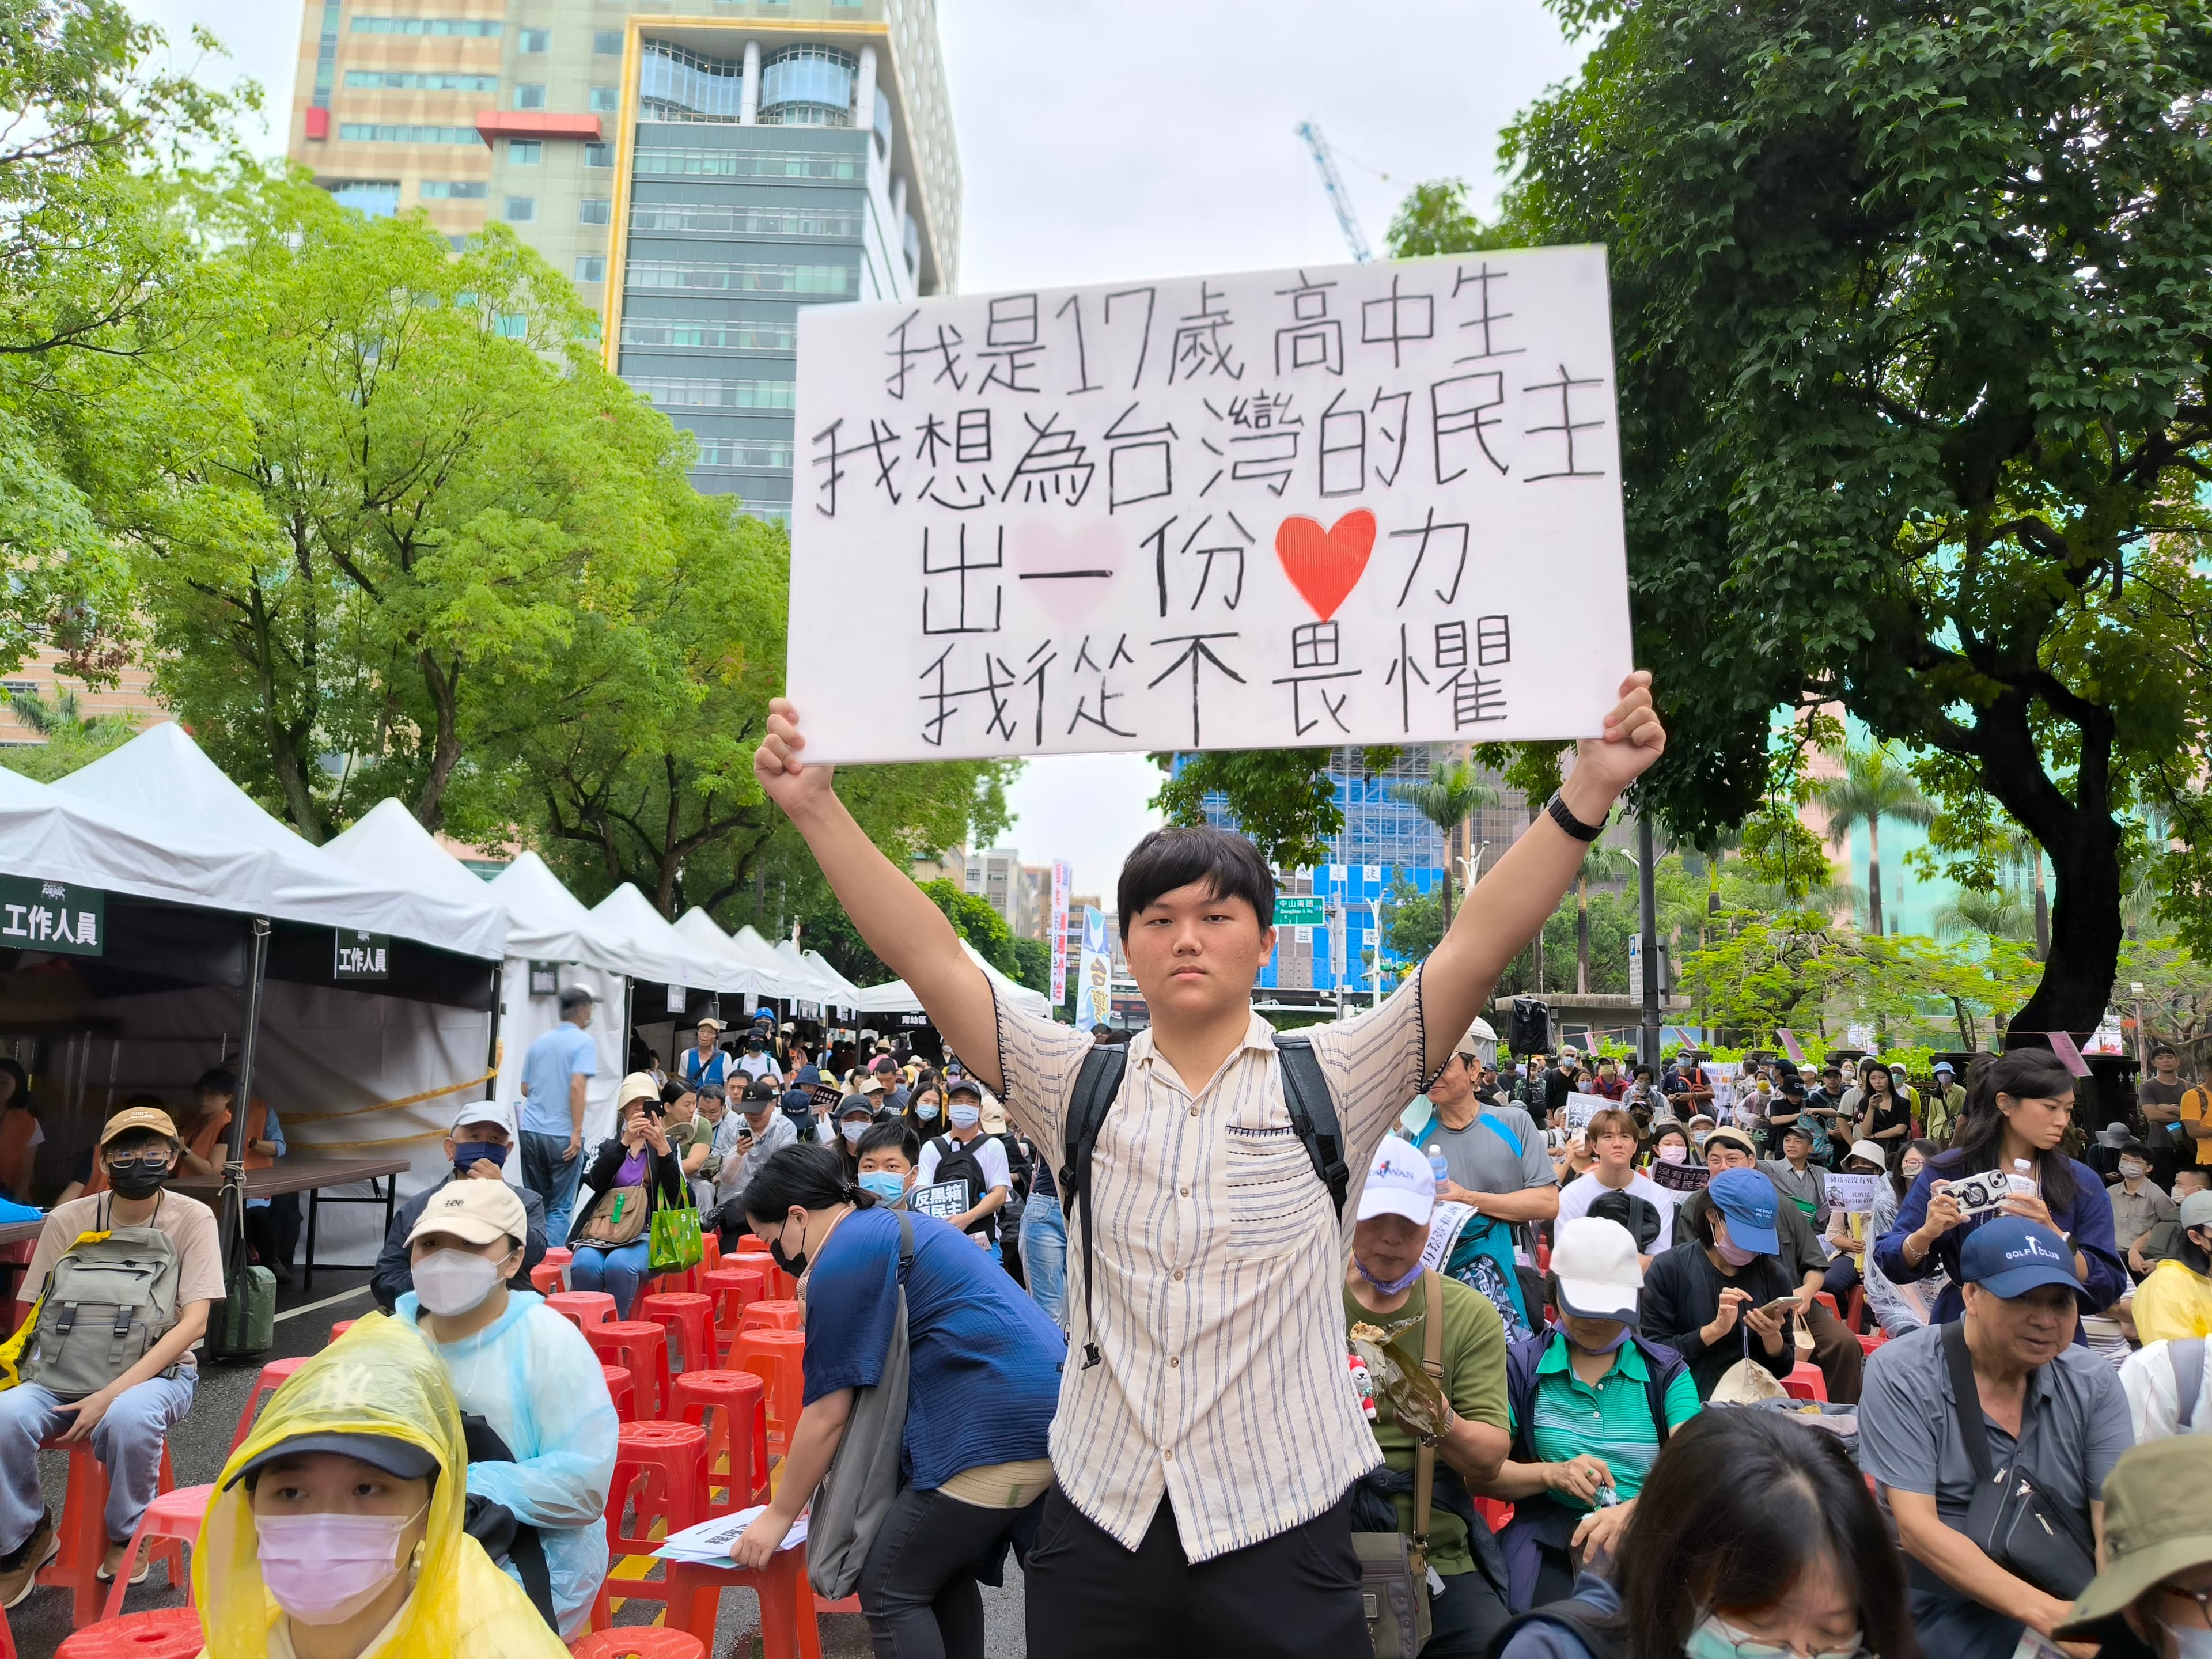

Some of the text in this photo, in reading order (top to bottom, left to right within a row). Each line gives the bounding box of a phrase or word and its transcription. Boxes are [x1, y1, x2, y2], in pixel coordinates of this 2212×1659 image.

[812, 365, 1605, 517] 我想為台灣的民主
[920, 614, 1512, 747] 我從不畏懼
[1279, 899, 1313, 907] 中山南路
[3, 904, 97, 946] 工作人員
[339, 947, 387, 972] 工作人員
[1658, 1166, 1709, 1181] 沒有討論
[445, 1199, 464, 1207] Lee
[915, 1184, 962, 1207] 反黑箱
[1423, 1205, 1461, 1267] 豬哥亮沒有
[2005, 1246, 2061, 1260] GOLF CLUB
